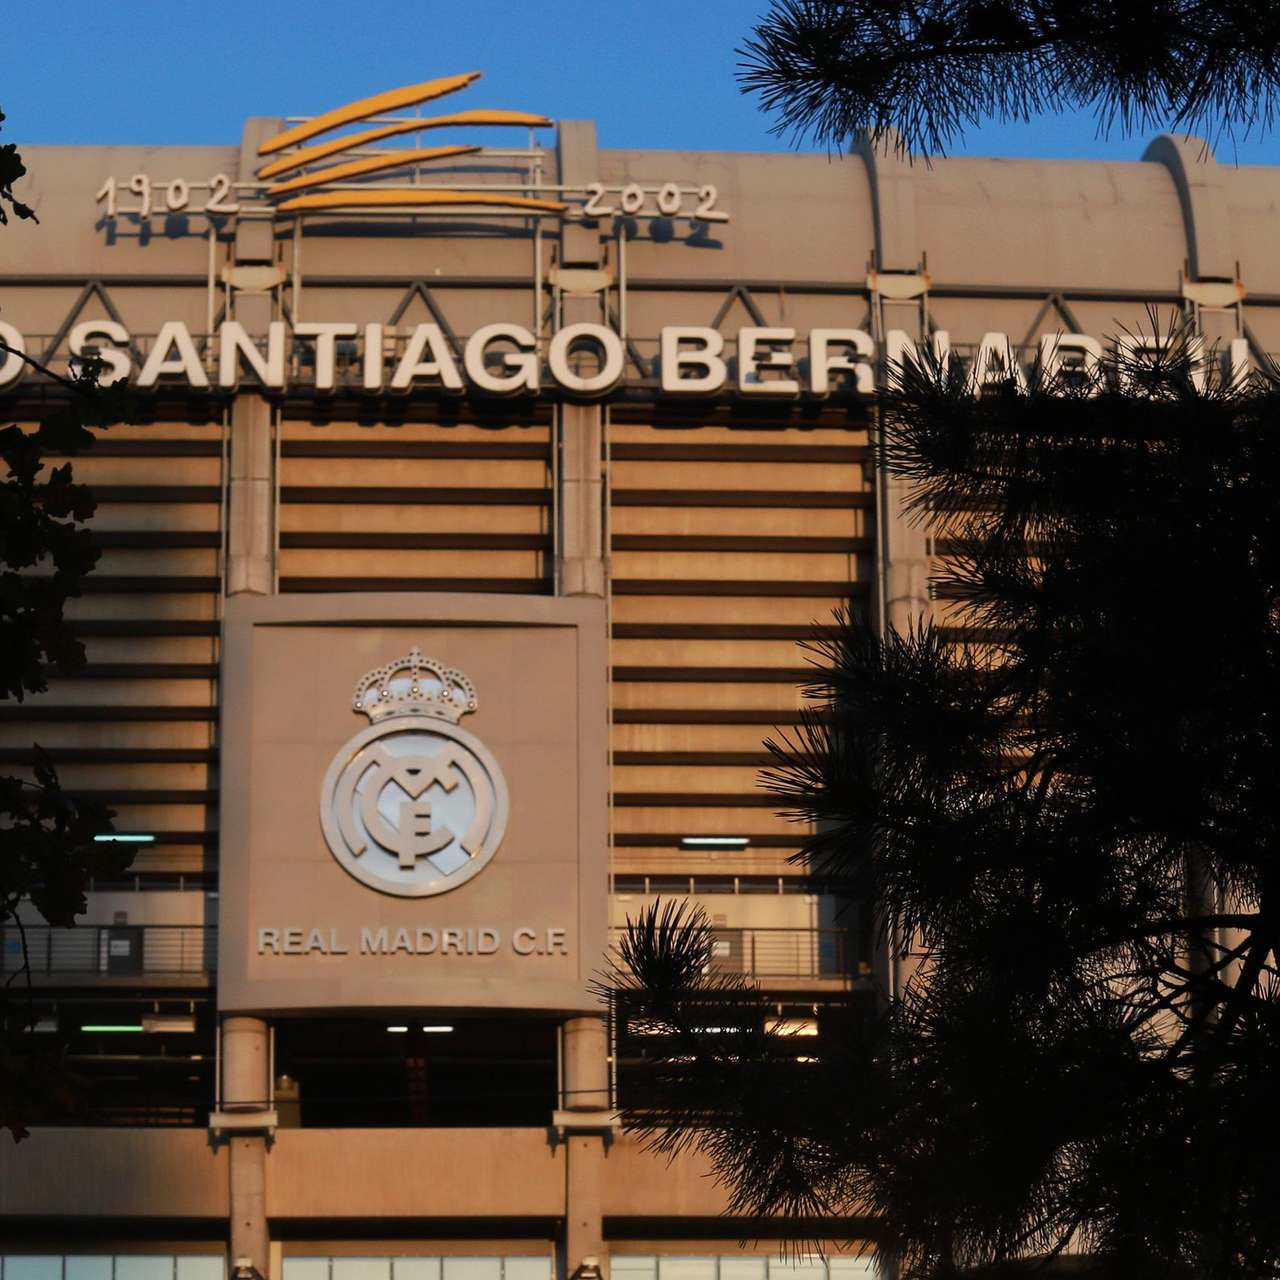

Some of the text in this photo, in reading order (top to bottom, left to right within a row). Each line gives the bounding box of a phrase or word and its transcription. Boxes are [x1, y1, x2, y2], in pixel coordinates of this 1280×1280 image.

[96, 174, 729, 223] 1902 2002
[67, 320, 622, 392] SANTIAGO
[257, 928, 349, 955] REAL
[360, 928, 501, 955] MADRID
